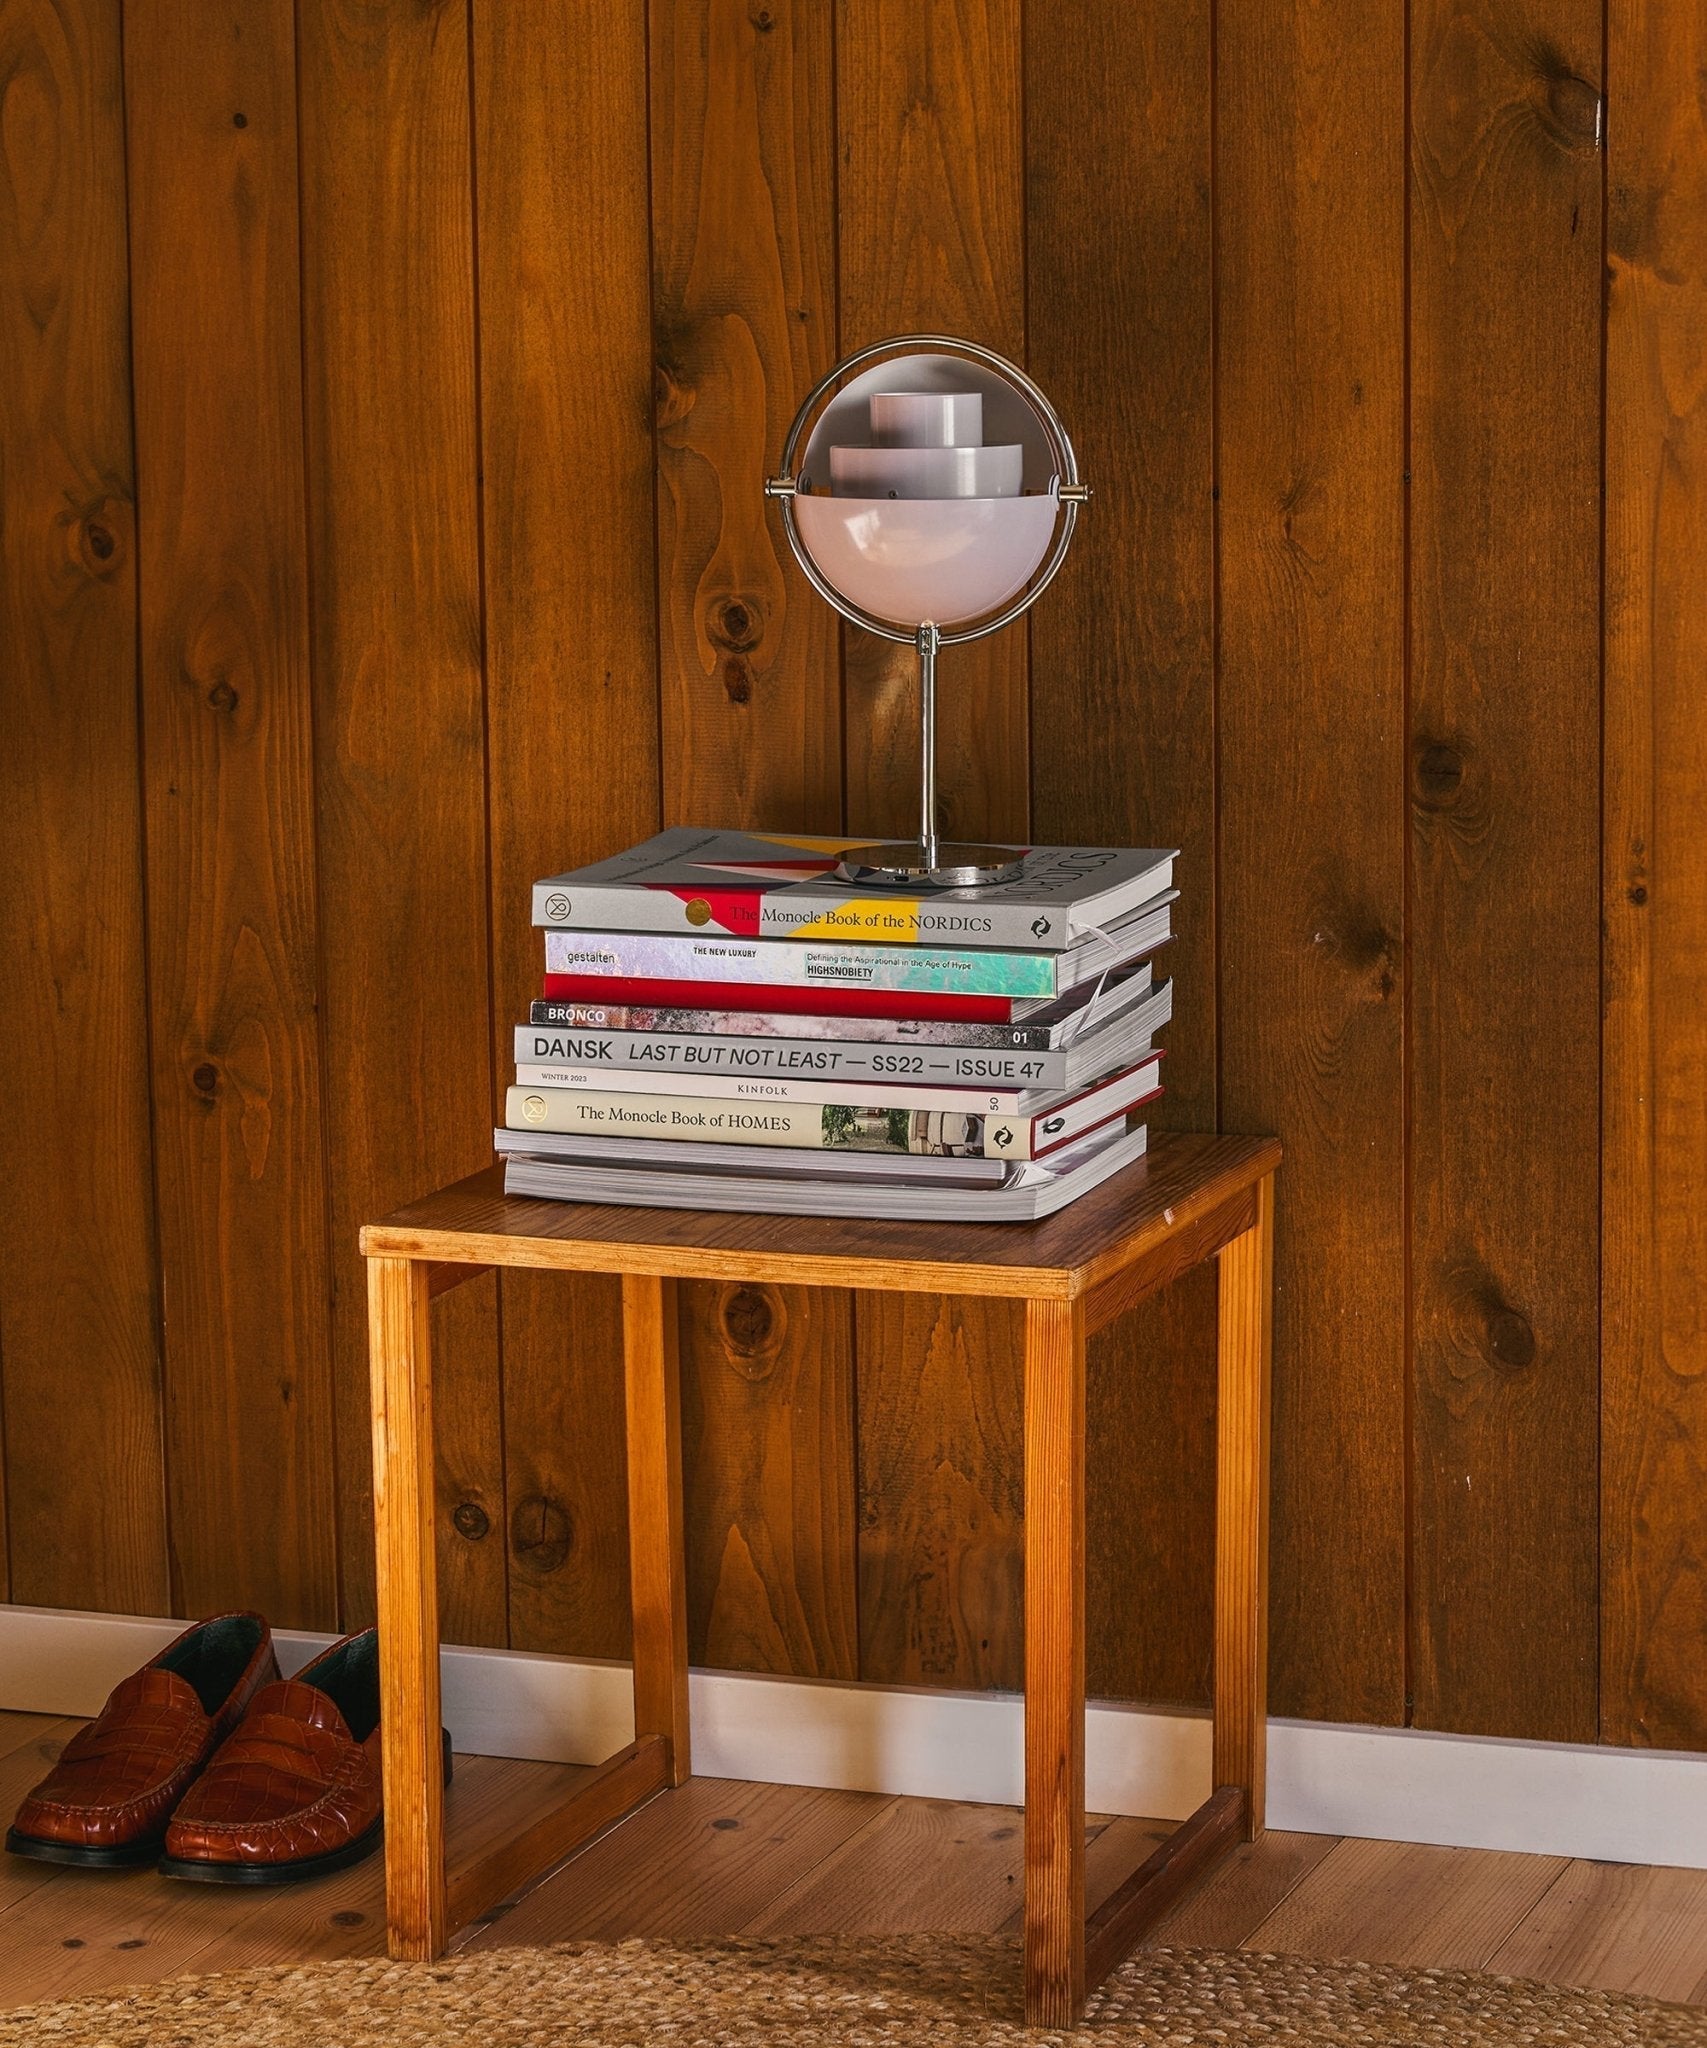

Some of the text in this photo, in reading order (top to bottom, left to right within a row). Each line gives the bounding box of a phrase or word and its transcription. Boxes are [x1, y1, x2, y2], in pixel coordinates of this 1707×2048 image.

[729, 906, 992, 932] The Monocle Book of the NORDICS
[567, 951, 615, 964] gestalten
[693, 946, 757, 959] THE NEW LUXURY
[807, 953, 972, 971] Defining the Aspirational in the Age of Hype
[807, 965, 874, 978] HIGHSNOBIETY
[548, 1007, 605, 1023] BRONCO
[1012, 1032, 1028, 1045] 01
[534, 1037, 613, 1060] DANSK
[629, 1043, 681, 1062] LAST
[684, 1046, 727, 1064] BUT
[729, 1048, 774, 1067] NOT
[777, 1050, 842, 1070] LEAST
[872, 1054, 923, 1074] SS22
[956, 1059, 1015, 1078] ISSUE
[1020, 1062, 1045, 1079] 47
[541, 1072, 588, 1083] WINTER 2023
[737, 1084, 788, 1096] KINFOLK
[989, 1096, 999, 1112] 50
[577, 1105, 791, 1132] The Monocle Book of HOMES
